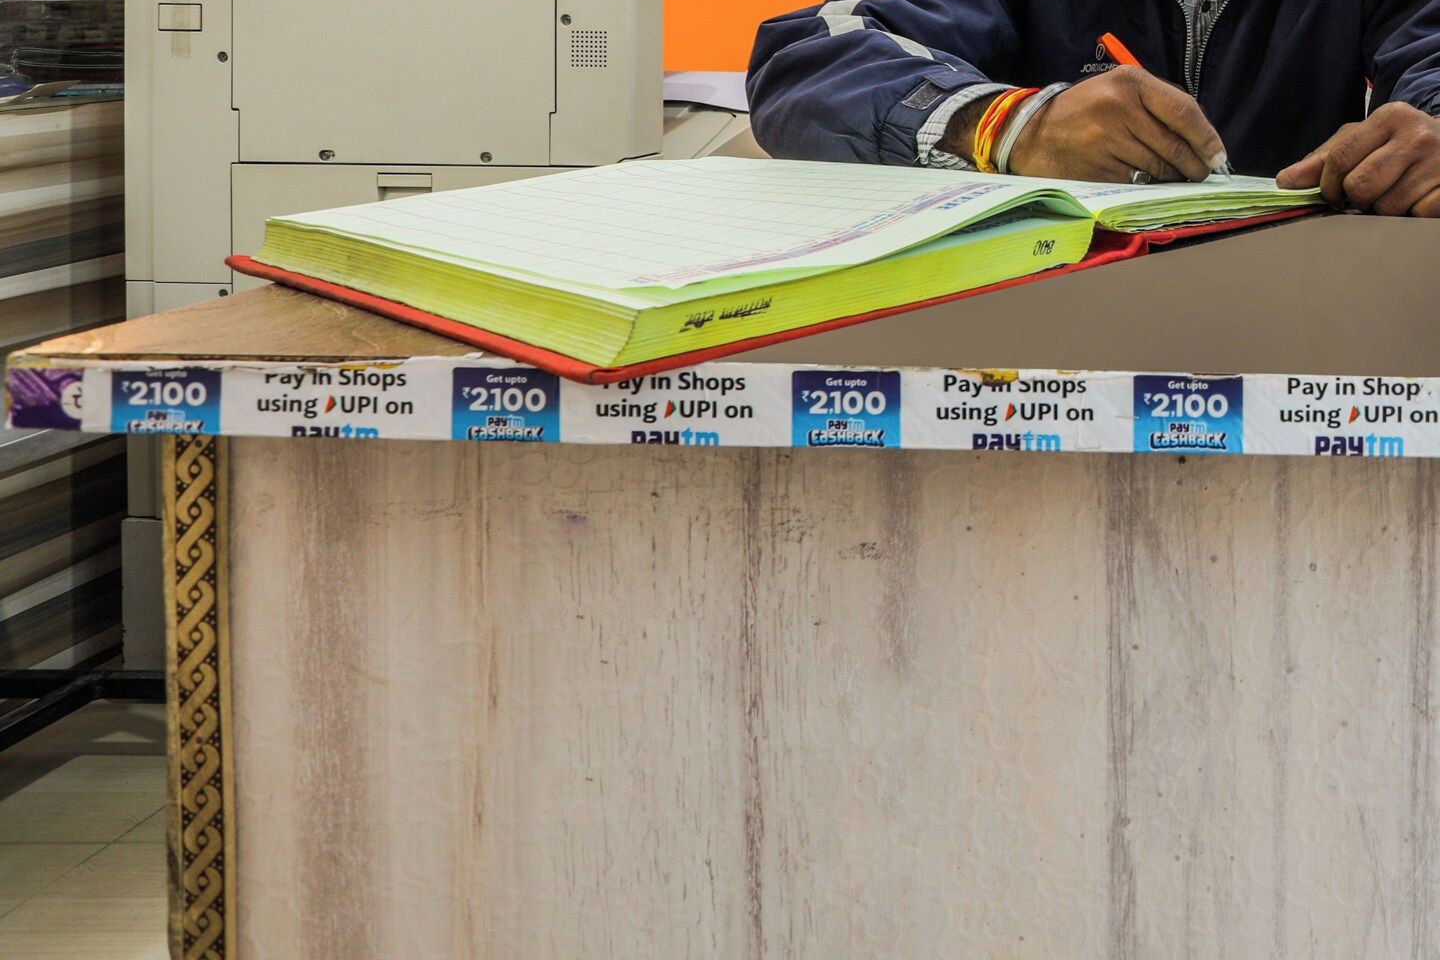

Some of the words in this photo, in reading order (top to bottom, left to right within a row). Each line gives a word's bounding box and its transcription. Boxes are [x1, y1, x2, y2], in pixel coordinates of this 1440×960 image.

[486, 374, 503, 384] Get
[505, 375, 527, 385] upto
[650, 371, 670, 389] in
[678, 372, 745, 395] Shops
[1167, 380, 1185, 390] Get
[1186, 381, 1208, 392] upto
[1288, 378, 1328, 400] Pay
[1336, 378, 1355, 395] in
[258, 396, 318, 418] using
[341, 396, 377, 413] UPI
[386, 402, 412, 414] on
[596, 399, 657, 423] using
[680, 401, 716, 418] UPI
[725, 406, 752, 418] on
[1280, 405, 1341, 428] using
[1365, 406, 1401, 422] UPI
[1410, 411, 1438, 423] on
